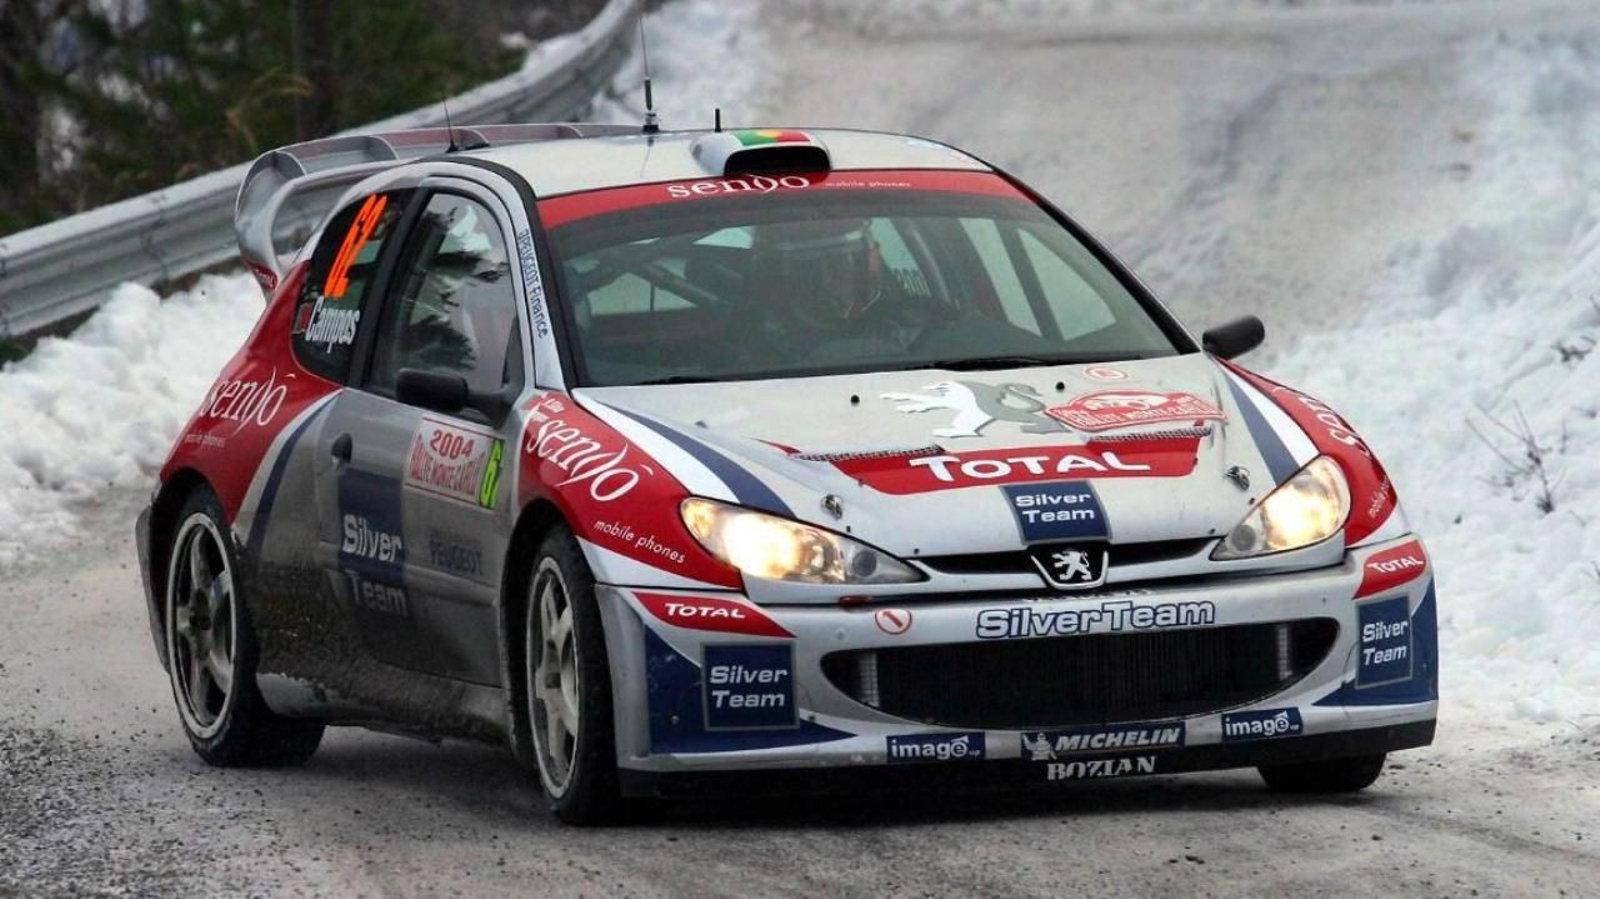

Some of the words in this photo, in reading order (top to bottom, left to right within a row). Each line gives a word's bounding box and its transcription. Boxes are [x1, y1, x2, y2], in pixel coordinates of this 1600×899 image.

[667, 174, 810, 198] sendo
[323, 193, 388, 298] 62
[305, 295, 361, 354] Campos
[528, 286, 549, 340] Finance
[199, 365, 288, 437] sendo
[430, 430, 475, 459] 2004
[526, 419, 640, 501] sendo
[909, 451, 1151, 482] TOTAL
[1016, 493, 1091, 508] Silver
[1023, 507, 1095, 524] Team
[342, 513, 402, 562] Silver
[594, 519, 635, 542] mobile
[635, 535, 686, 564] phones
[1366, 555, 1424, 573] TOTAL
[344, 568, 408, 617] Team
[664, 602, 746, 618] TOTAL
[976, 600, 1215, 639] SilverTeam
[1362, 619, 1409, 643] Silver
[1362, 645, 1408, 667] Team
[709, 665, 788, 685] Silver
[711, 690, 785, 708] Team
[1055, 728, 1181, 751] MICHELIN
[1047, 755, 1157, 781] BOZIAN
